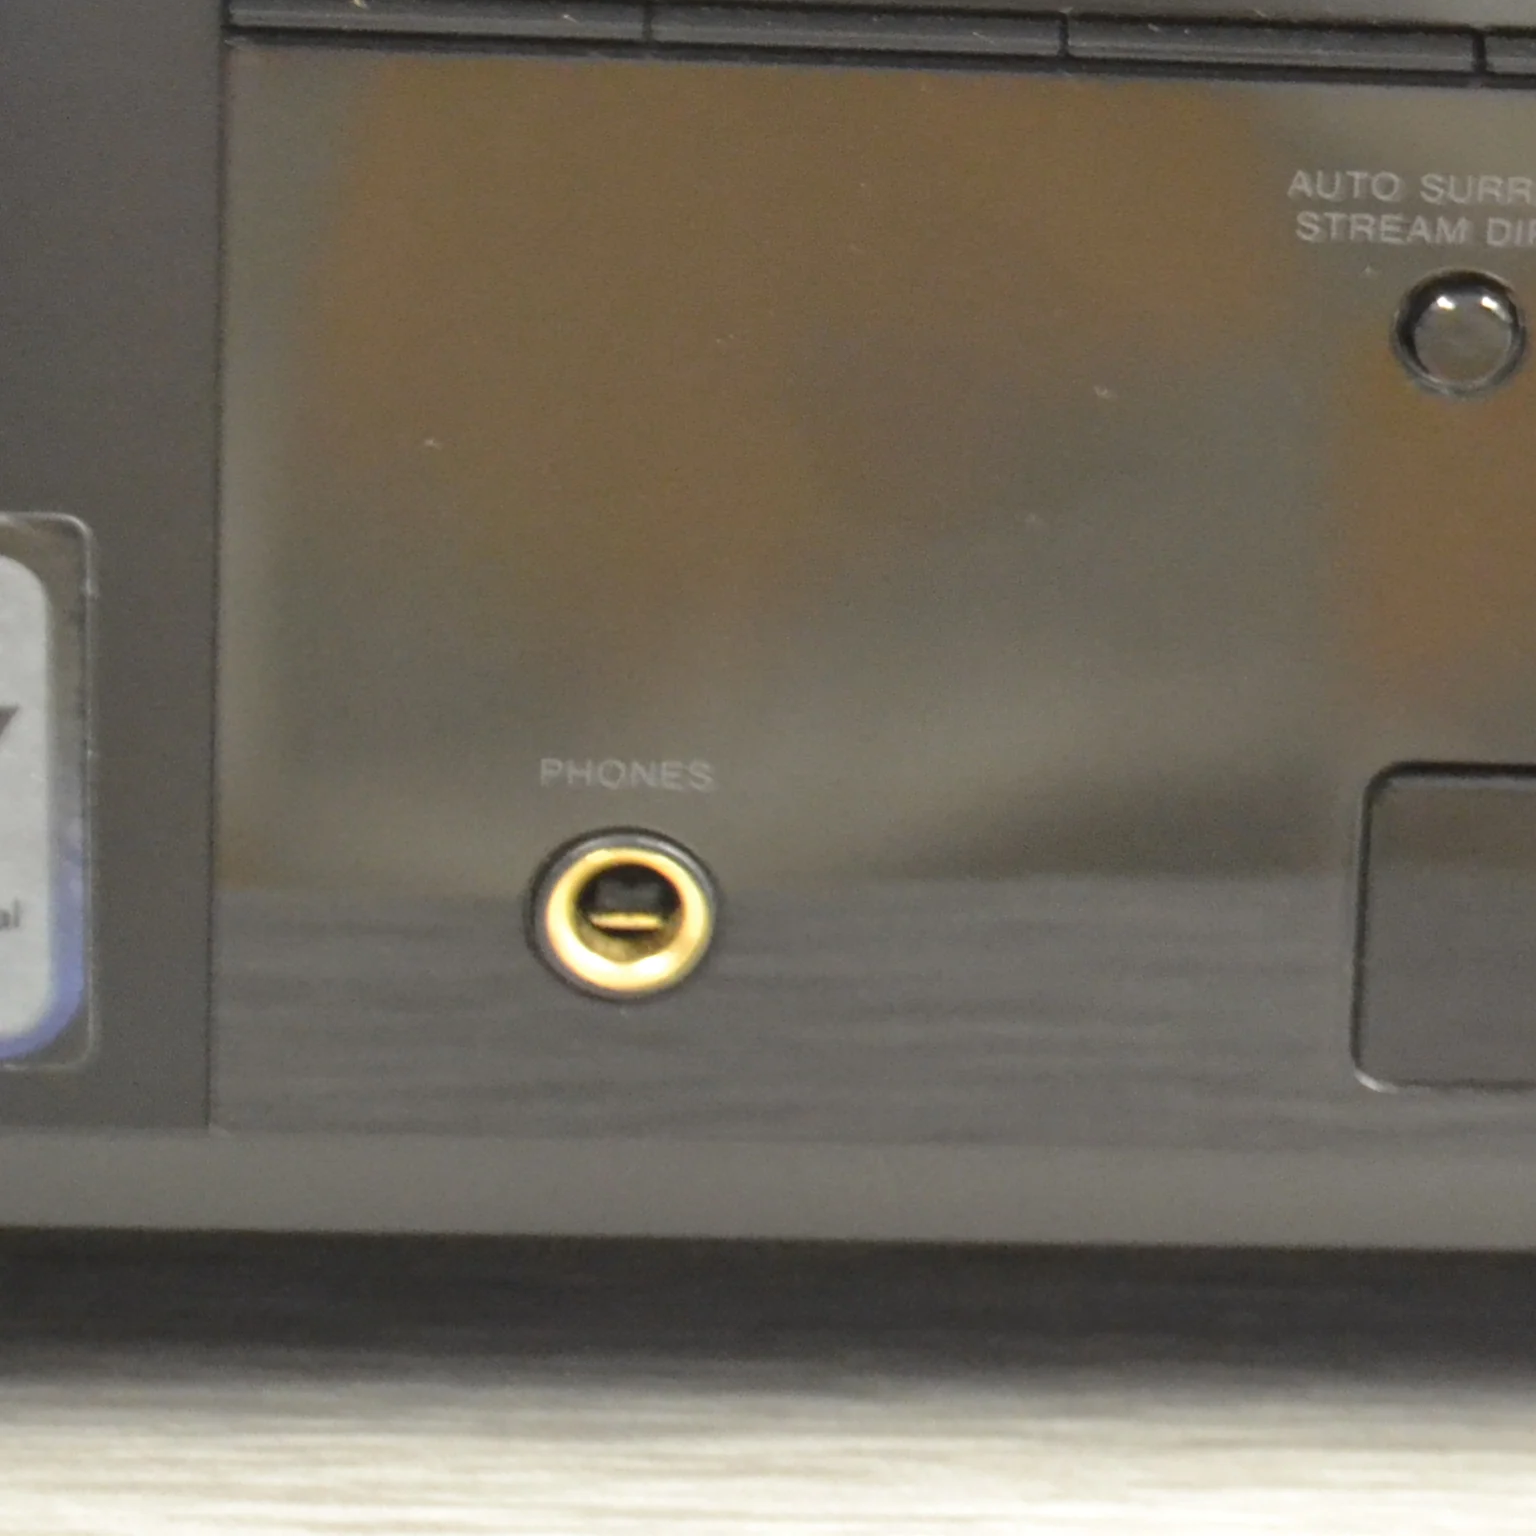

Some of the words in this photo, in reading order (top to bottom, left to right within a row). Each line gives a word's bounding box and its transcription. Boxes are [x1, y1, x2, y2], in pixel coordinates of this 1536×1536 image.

[1287, 169, 1404, 202] AUTO
[1294, 211, 1472, 245] STREAM
[539, 757, 714, 792] PHONES
